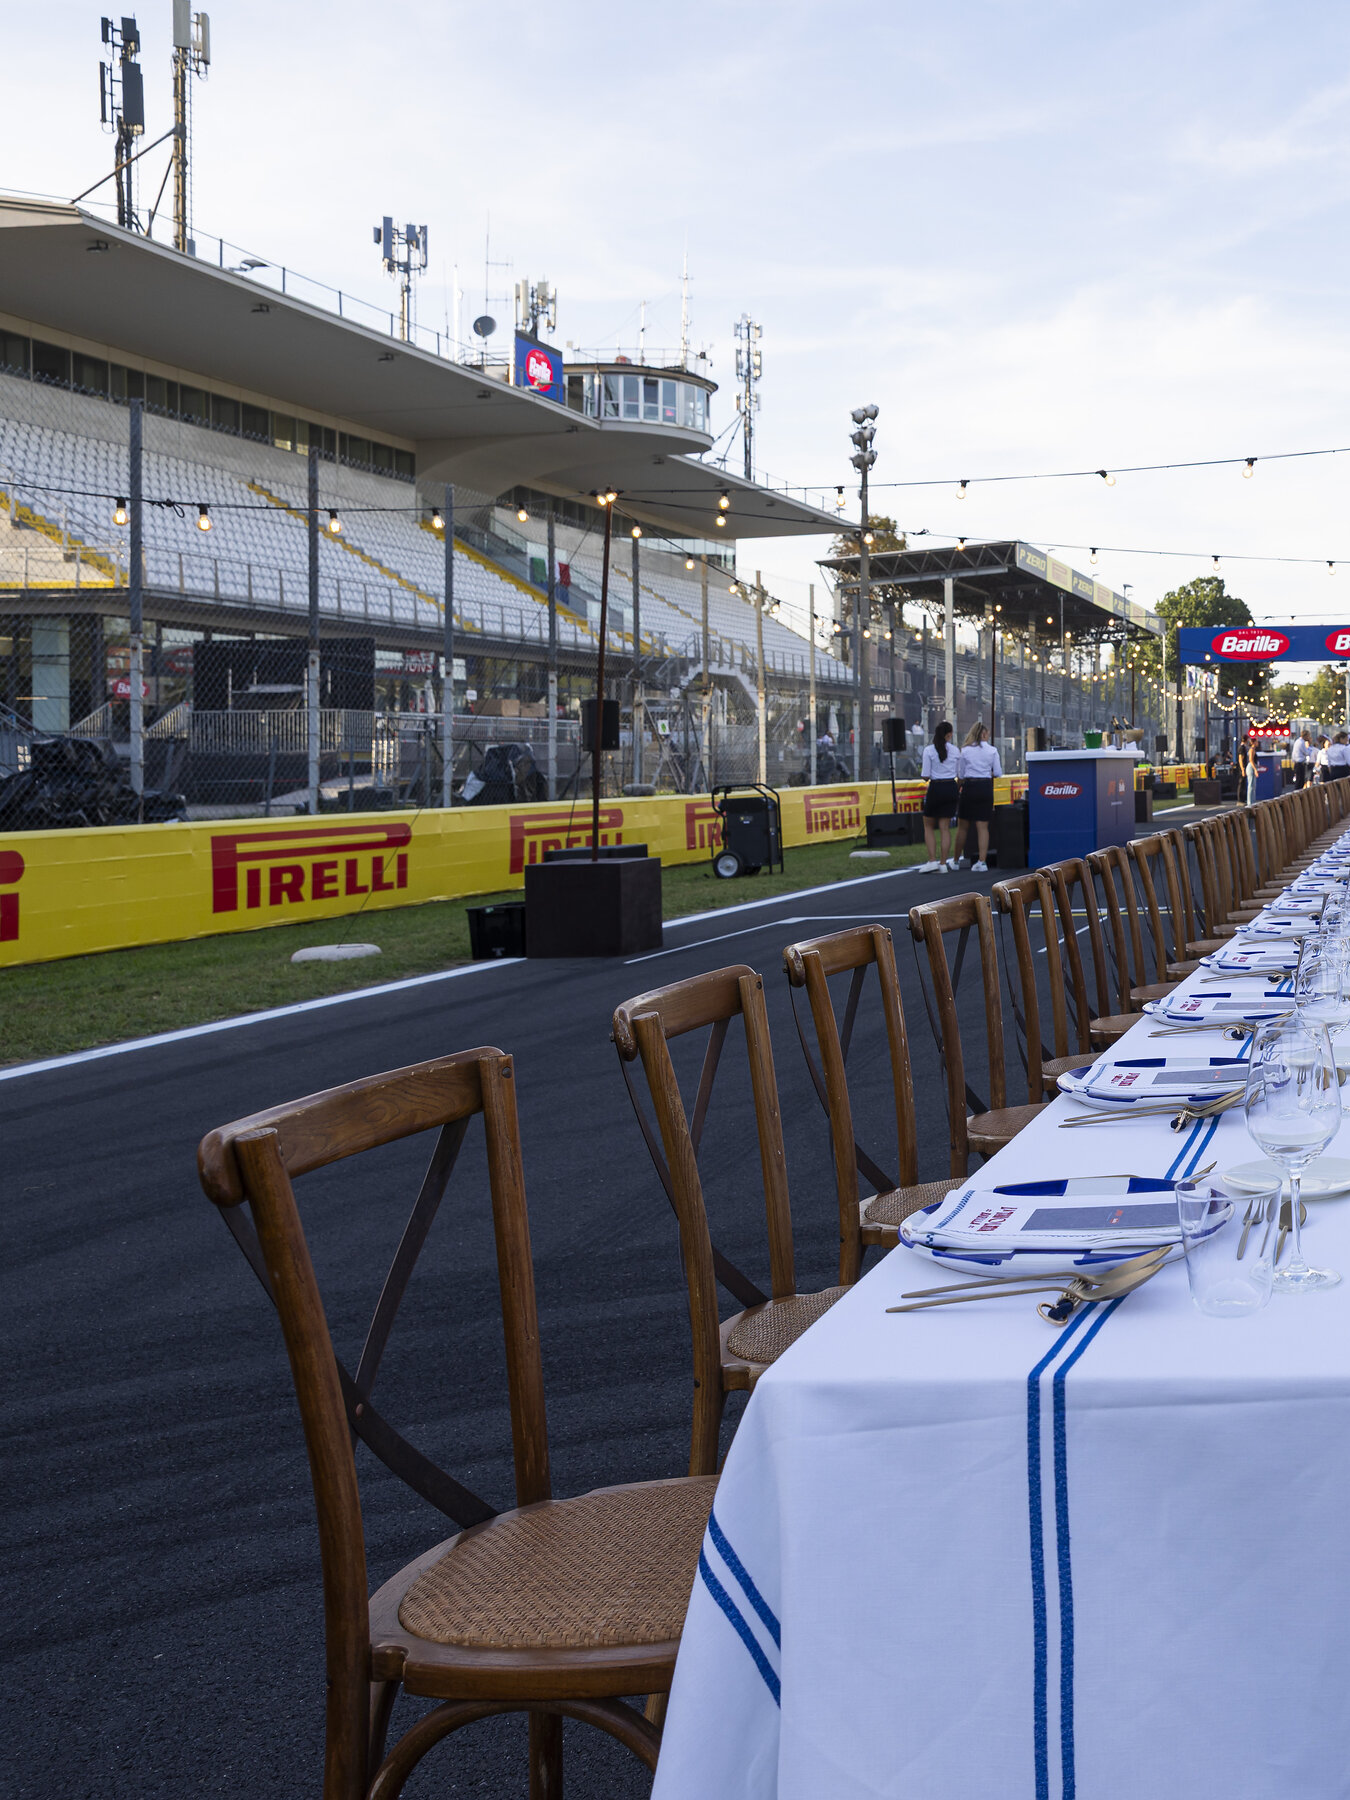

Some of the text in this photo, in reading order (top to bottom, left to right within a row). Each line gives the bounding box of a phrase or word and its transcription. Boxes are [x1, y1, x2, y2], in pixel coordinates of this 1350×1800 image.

[1221, 635, 1280, 653] Barilla
[1044, 785, 1078, 795] Barilla
[803, 791, 860, 834] PIRELLI
[211, 823, 412, 914] PIRELLI
